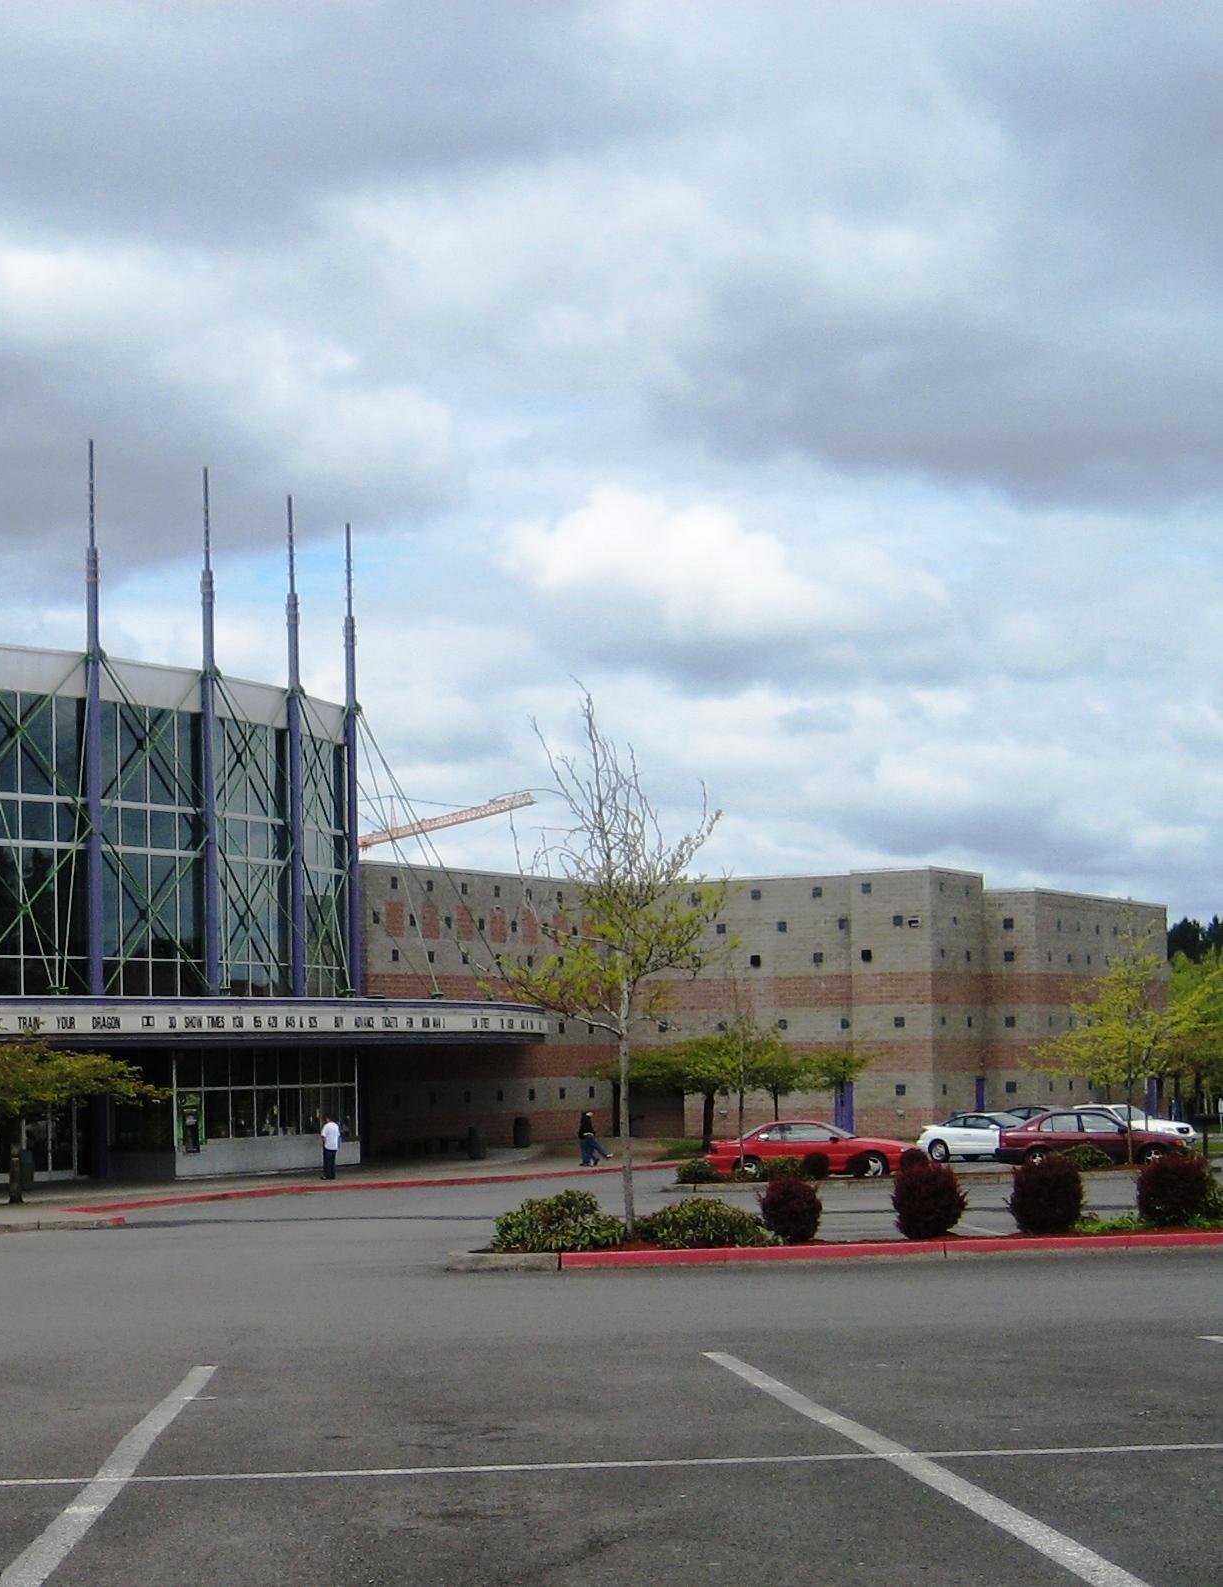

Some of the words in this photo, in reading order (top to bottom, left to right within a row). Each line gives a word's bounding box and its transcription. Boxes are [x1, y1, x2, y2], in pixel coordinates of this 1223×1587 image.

[18, 1016, 40, 1030] TRAIN
[56, 1016, 76, 1030] YOUR
[92, 1016, 121, 1030] DRAGON
[168, 1016, 177, 1029] 3D
[184, 1016, 203, 1029] SHOW
[207, 1016, 225, 1029] TIMES
